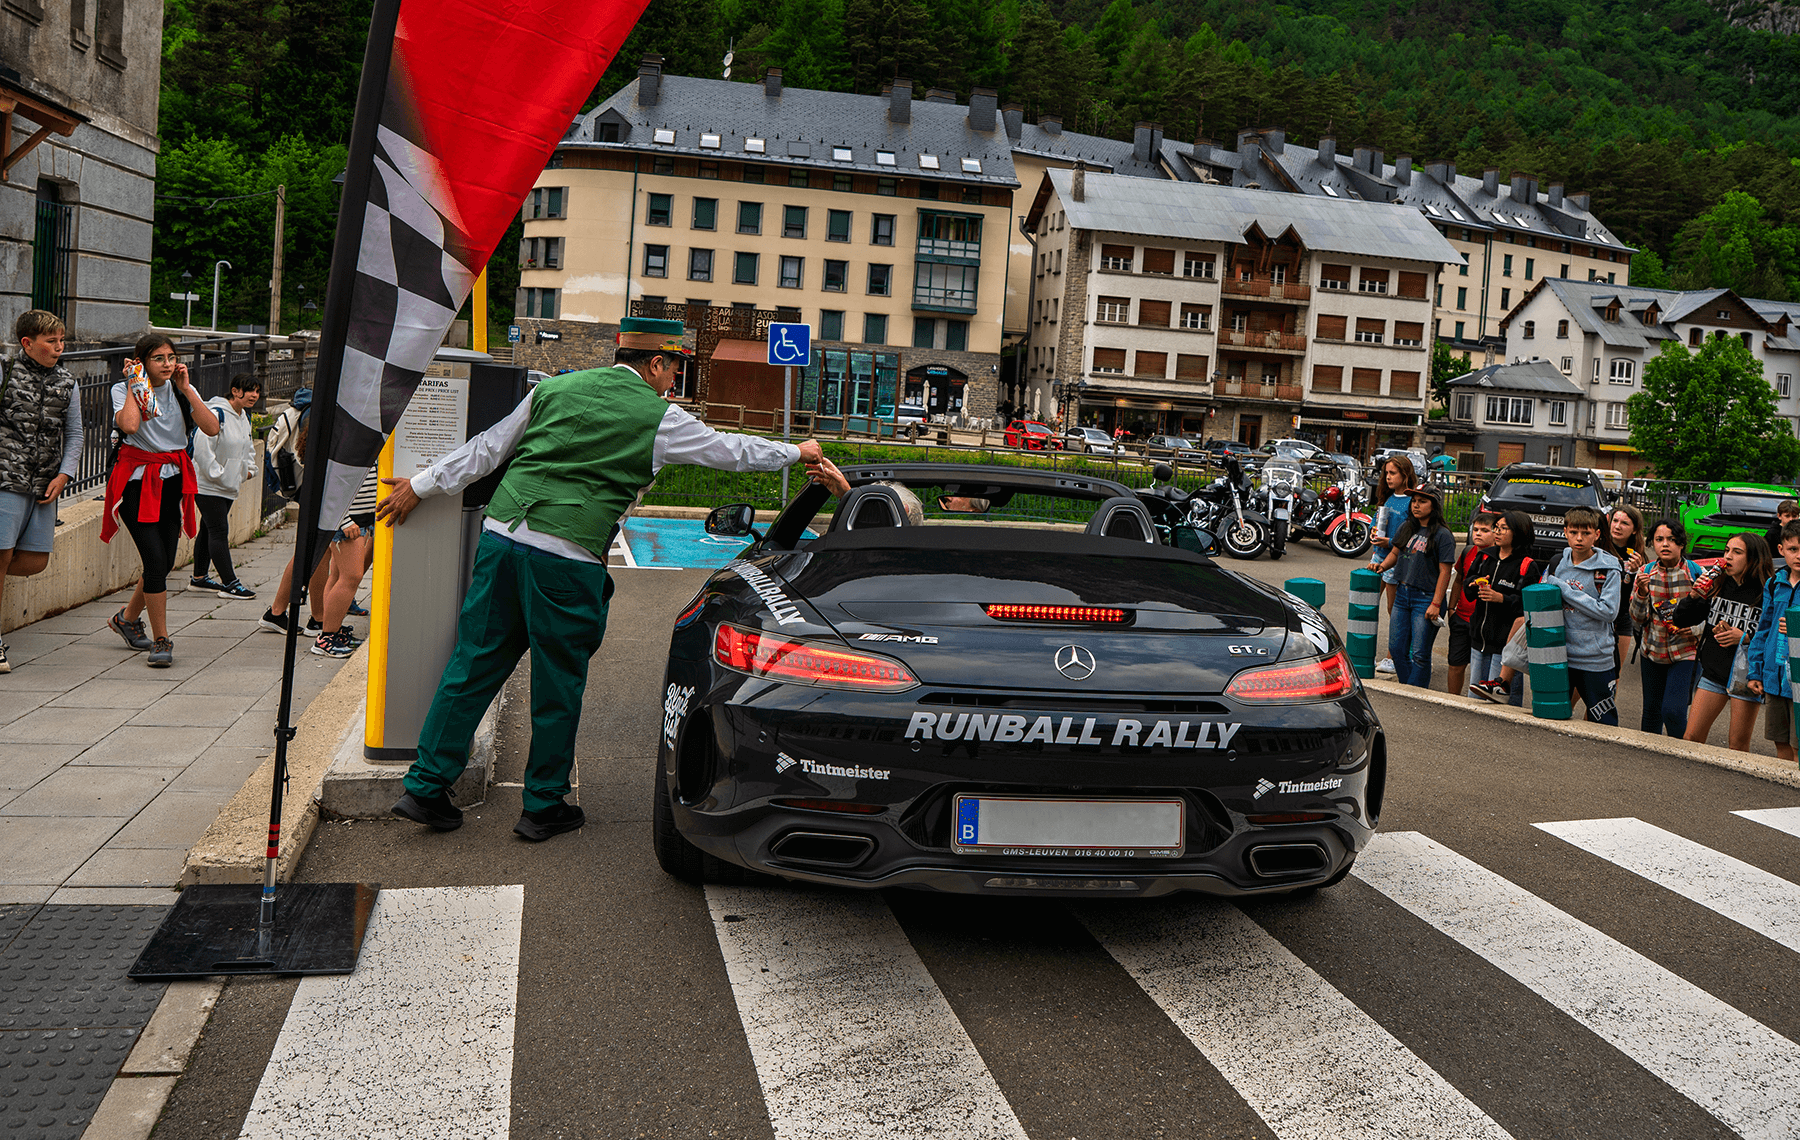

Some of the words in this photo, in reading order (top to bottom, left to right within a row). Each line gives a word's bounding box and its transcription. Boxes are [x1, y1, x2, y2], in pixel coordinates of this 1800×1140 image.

[1552, 480, 1584, 489] RALLY
[882, 634, 939, 644] AMG
[1228, 645, 1253, 654] GT
[904, 712, 1102, 745] RUNBALL
[1111, 718, 1242, 749] RALLY
[800, 759, 890, 780] Tintmeister
[1278, 778, 1342, 794] Tintmeister
[962, 824, 974, 839] B
[1002, 848, 1068, 856] GMS-LEUVEN
